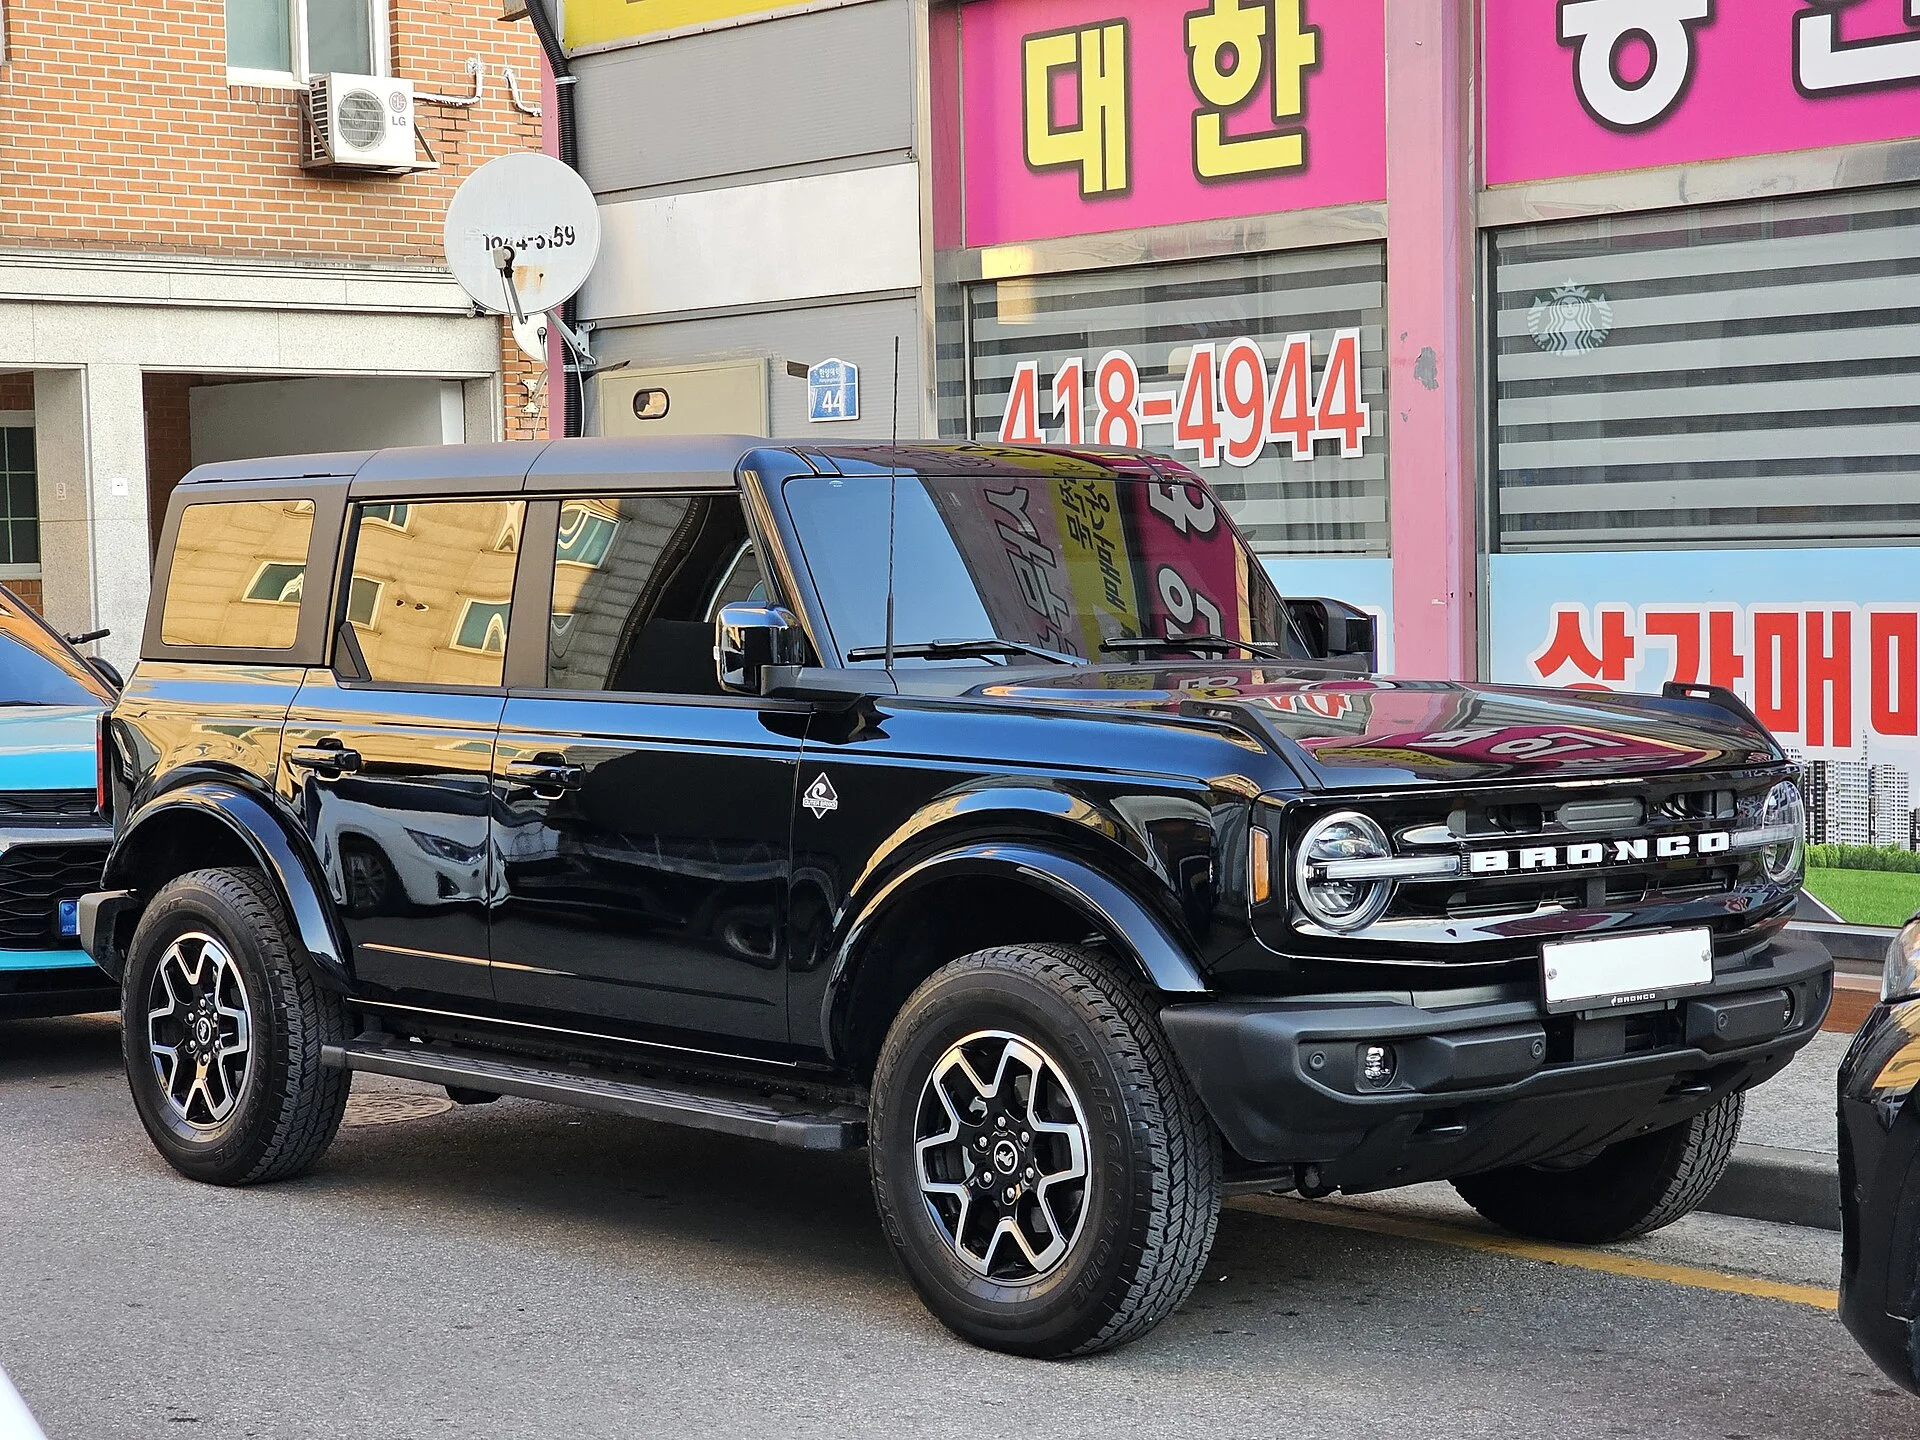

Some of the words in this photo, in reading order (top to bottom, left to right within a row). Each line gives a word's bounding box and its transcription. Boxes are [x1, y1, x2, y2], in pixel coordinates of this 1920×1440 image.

[391, 116, 407, 127] LG
[1000, 330, 1368, 466] 418-4944
[1470, 831, 1730, 873] BRONCO
[1616, 993, 1656, 1004] BRONCO
